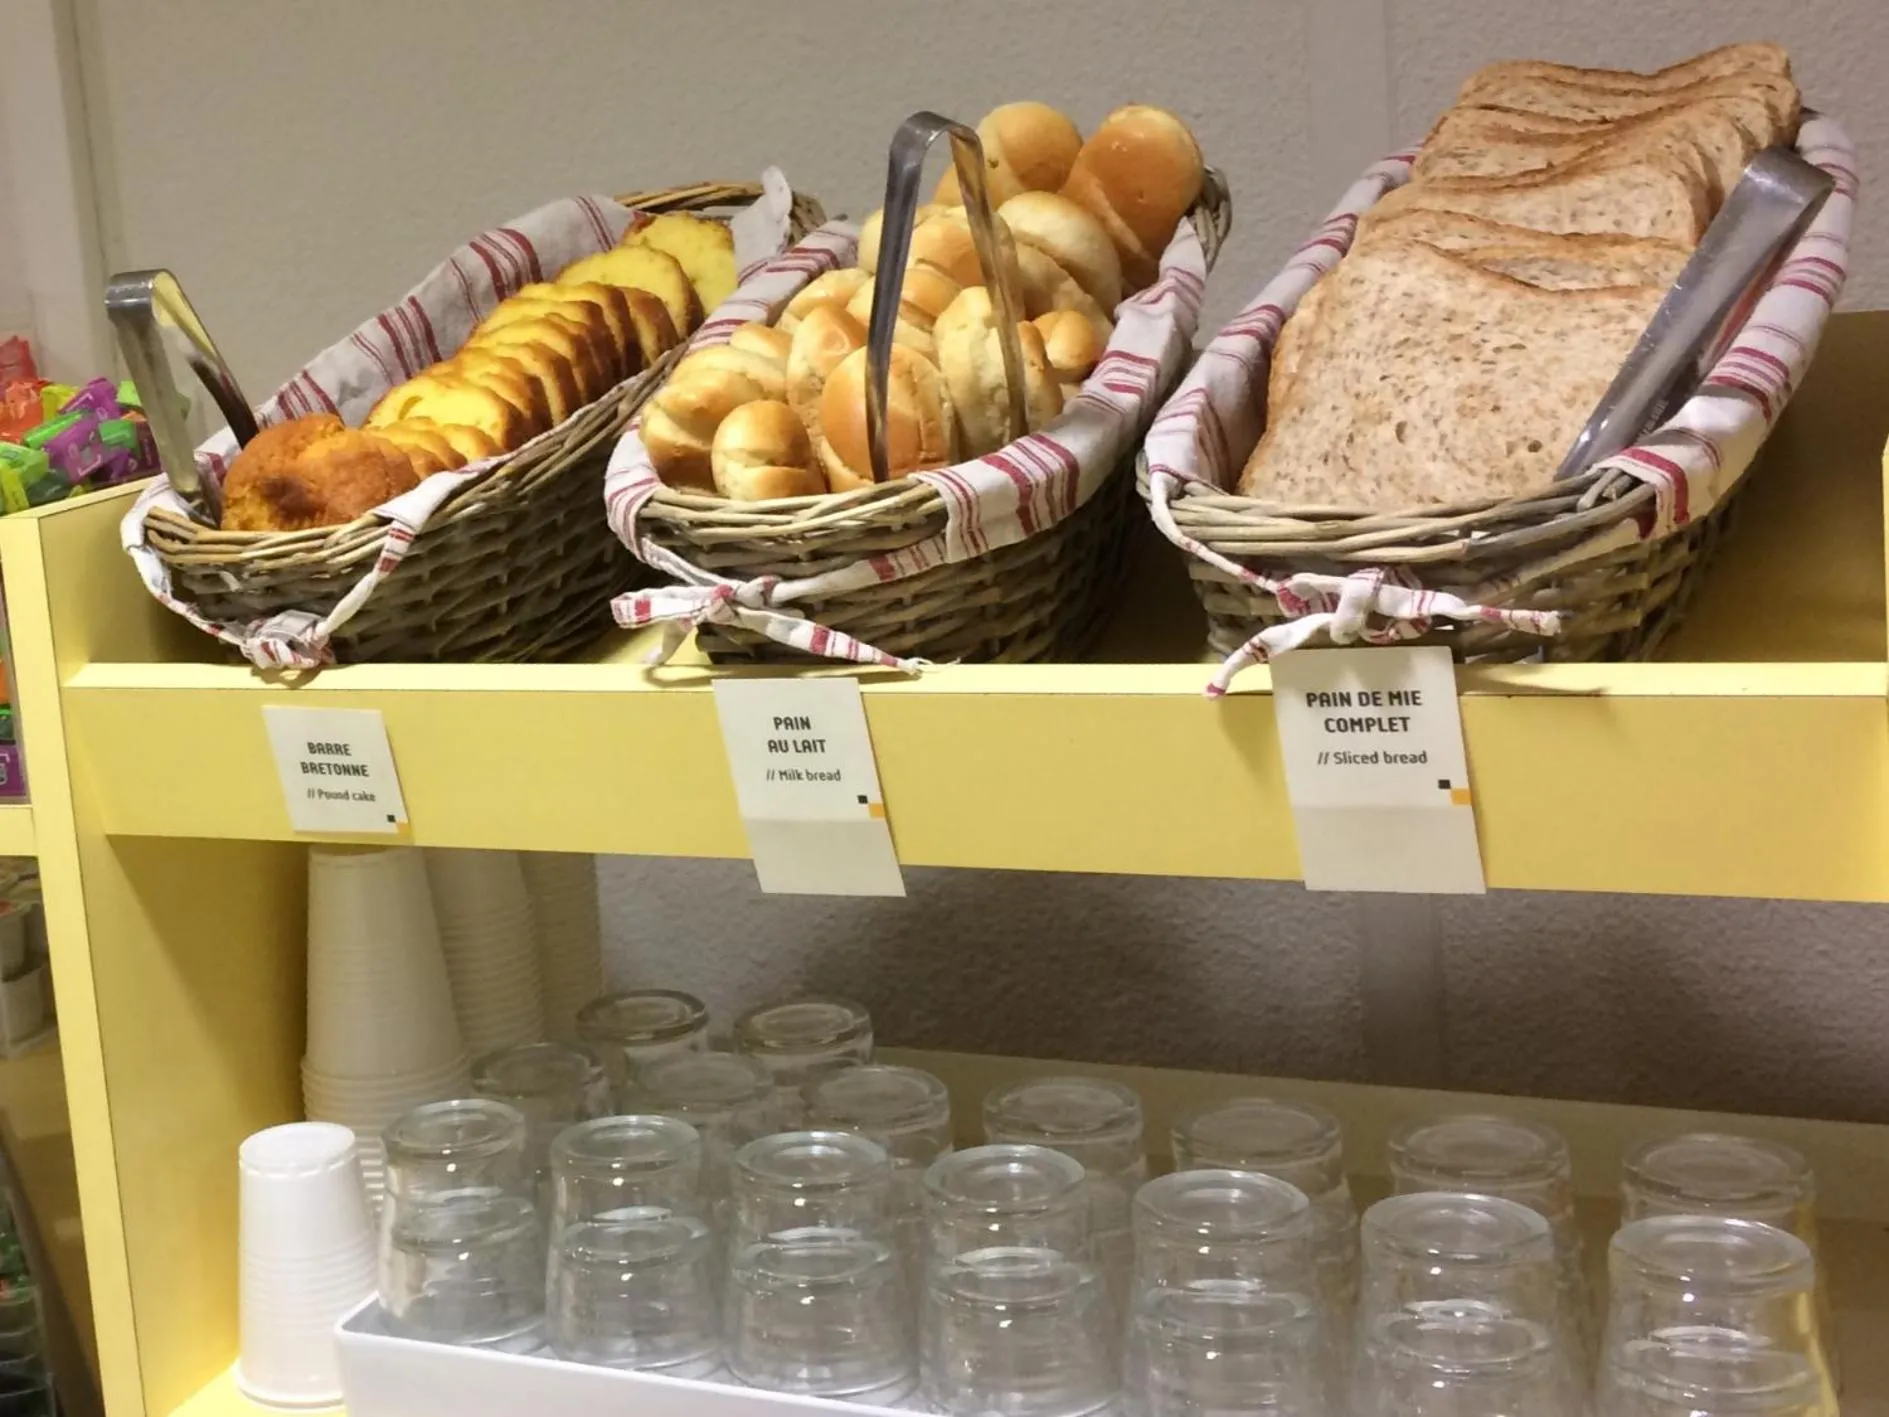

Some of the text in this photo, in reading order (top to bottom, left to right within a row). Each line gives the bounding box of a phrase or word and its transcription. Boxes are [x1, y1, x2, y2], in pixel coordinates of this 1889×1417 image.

[1306, 690, 1423, 708] PAIN DE MIE
[773, 716, 812, 731] PAIN
[1324, 716, 1411, 733] COMPLET
[307, 742, 352, 756] BARRE
[767, 739, 826, 754] AU LAIT
[1333, 750, 1379, 765] Sliced
[1384, 750, 1428, 765] bread
[300, 762, 369, 777] BRETONNE
[779, 769, 804, 781] Milk
[806, 769, 841, 781] bread
[317, 788, 350, 800] Pound
[352, 790, 376, 802] cake
